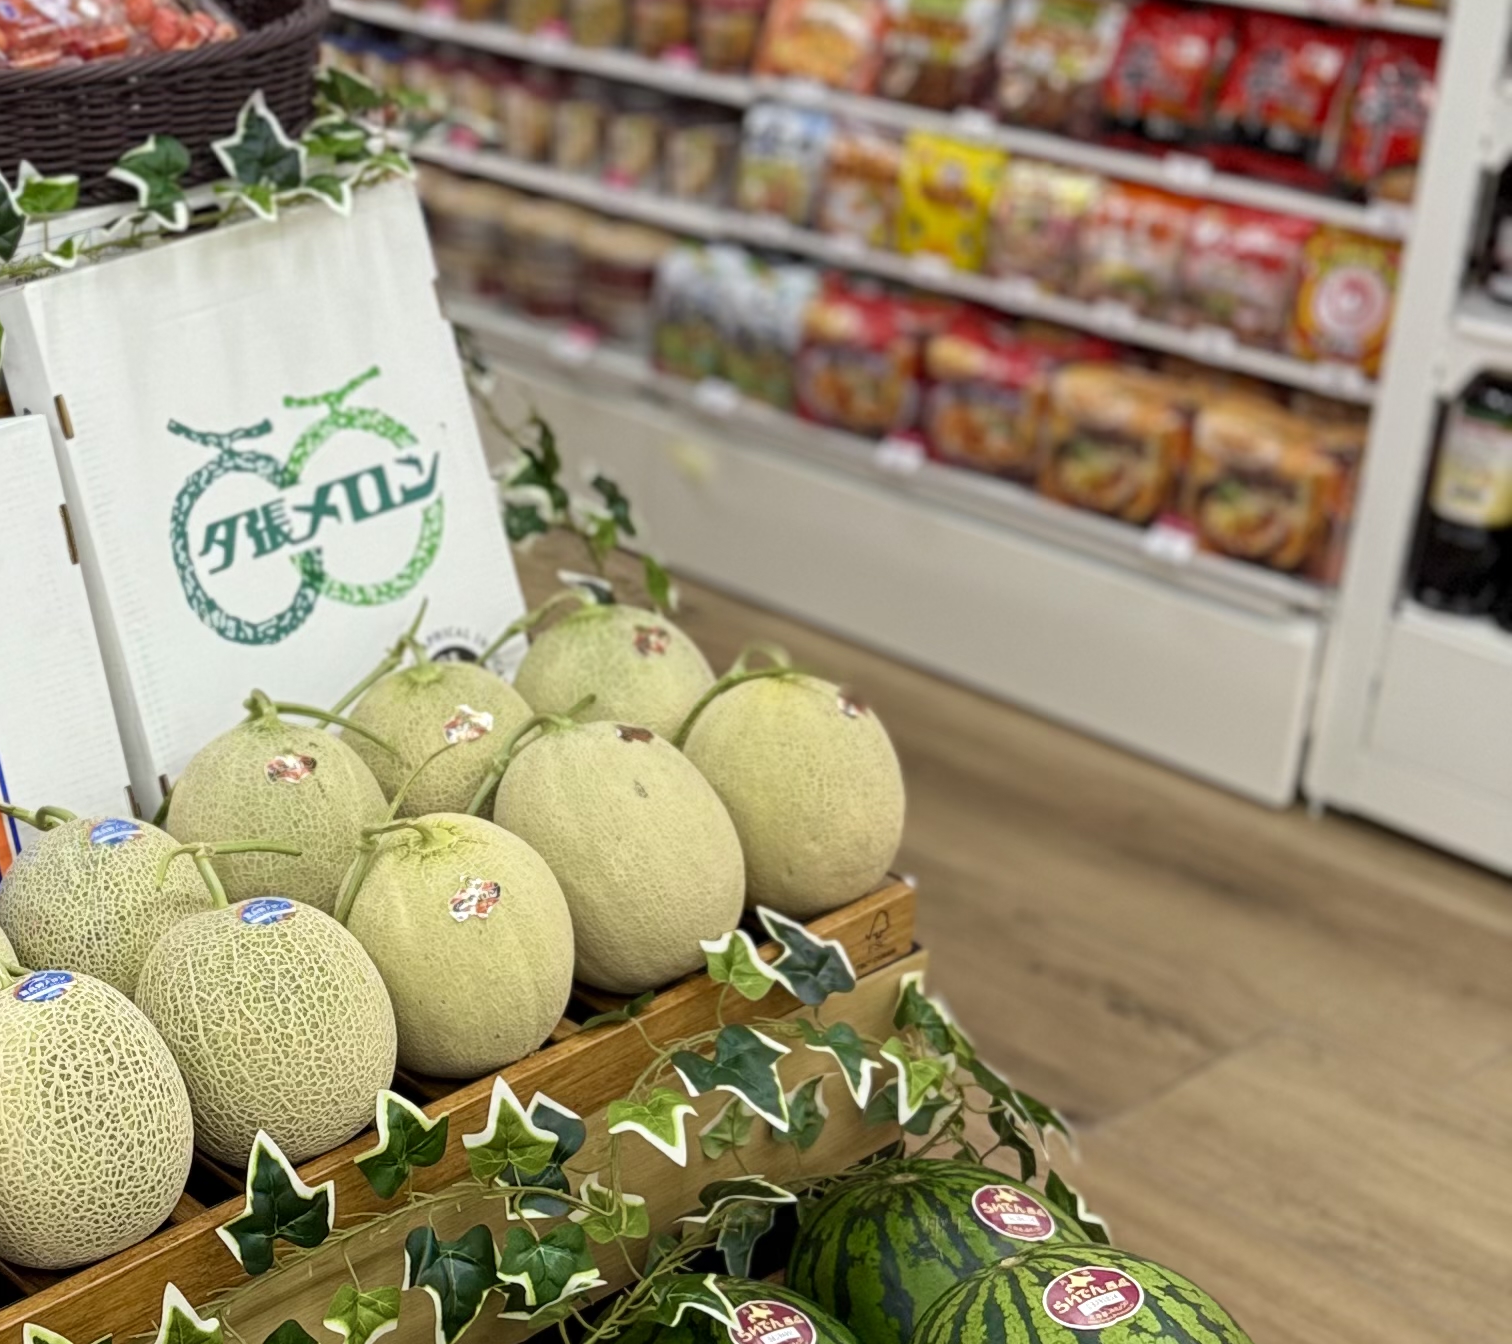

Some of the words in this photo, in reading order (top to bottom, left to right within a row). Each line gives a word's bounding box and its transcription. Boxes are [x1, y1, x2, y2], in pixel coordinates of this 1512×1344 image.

[198, 452, 441, 575] 夕張メロン
